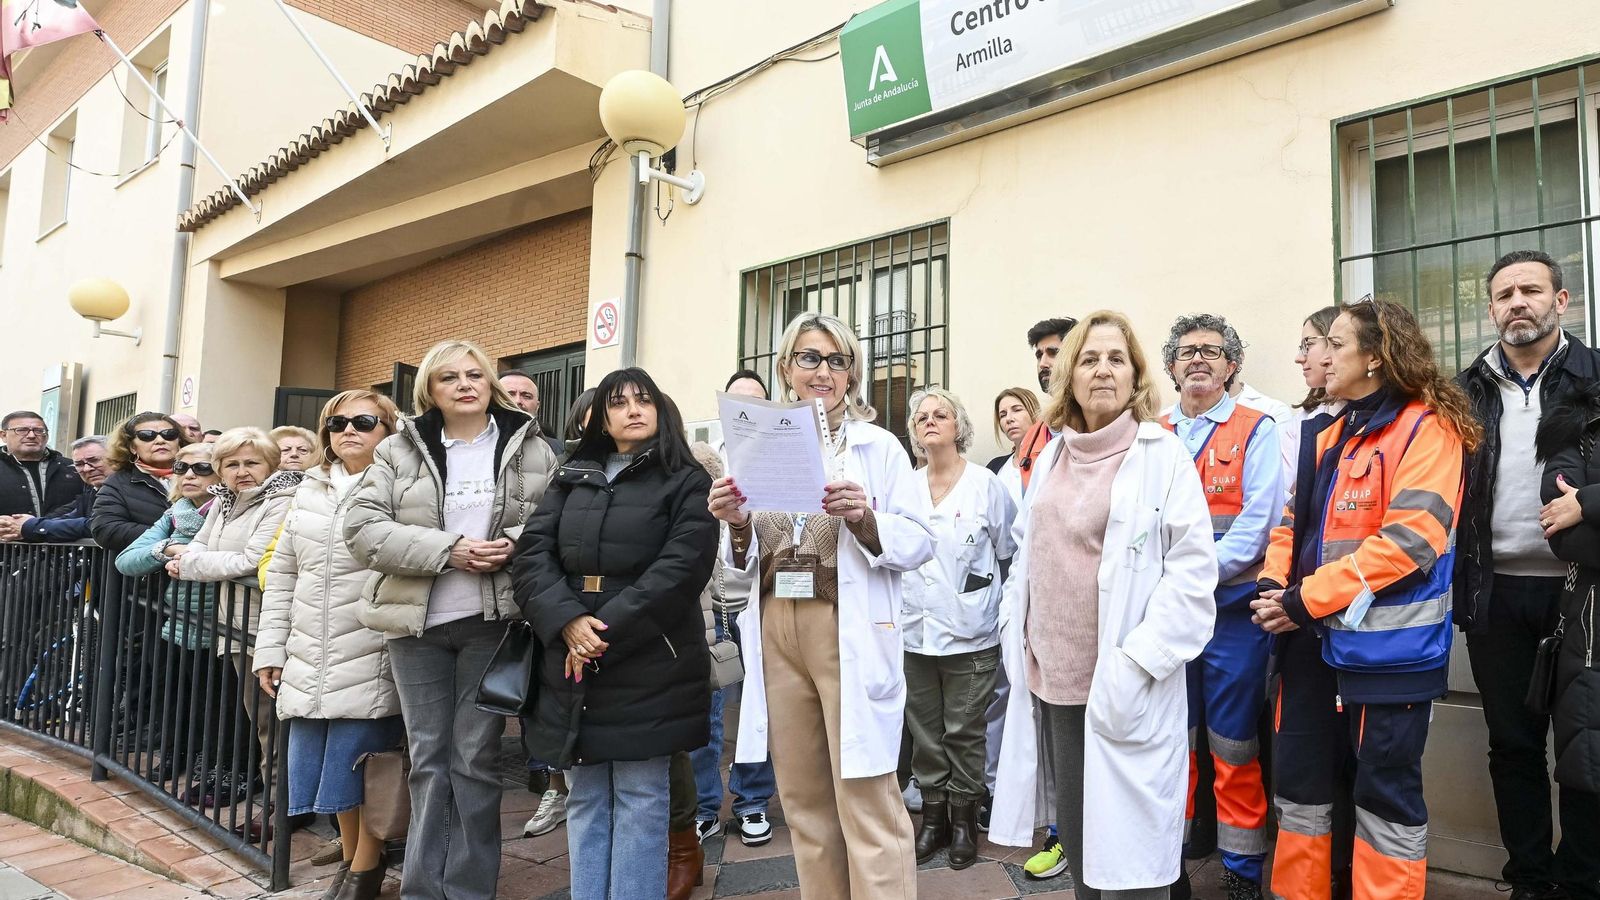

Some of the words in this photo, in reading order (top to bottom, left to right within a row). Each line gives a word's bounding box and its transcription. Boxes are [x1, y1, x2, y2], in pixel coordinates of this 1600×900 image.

[956, 36, 1013, 72] Armilla
[854, 99, 873, 111] Junta
[873, 93, 882, 103] de
[882, 77, 919, 100] Andalucía
[1212, 475, 1236, 484] SUAP
[1344, 489, 1371, 499] SUAP
